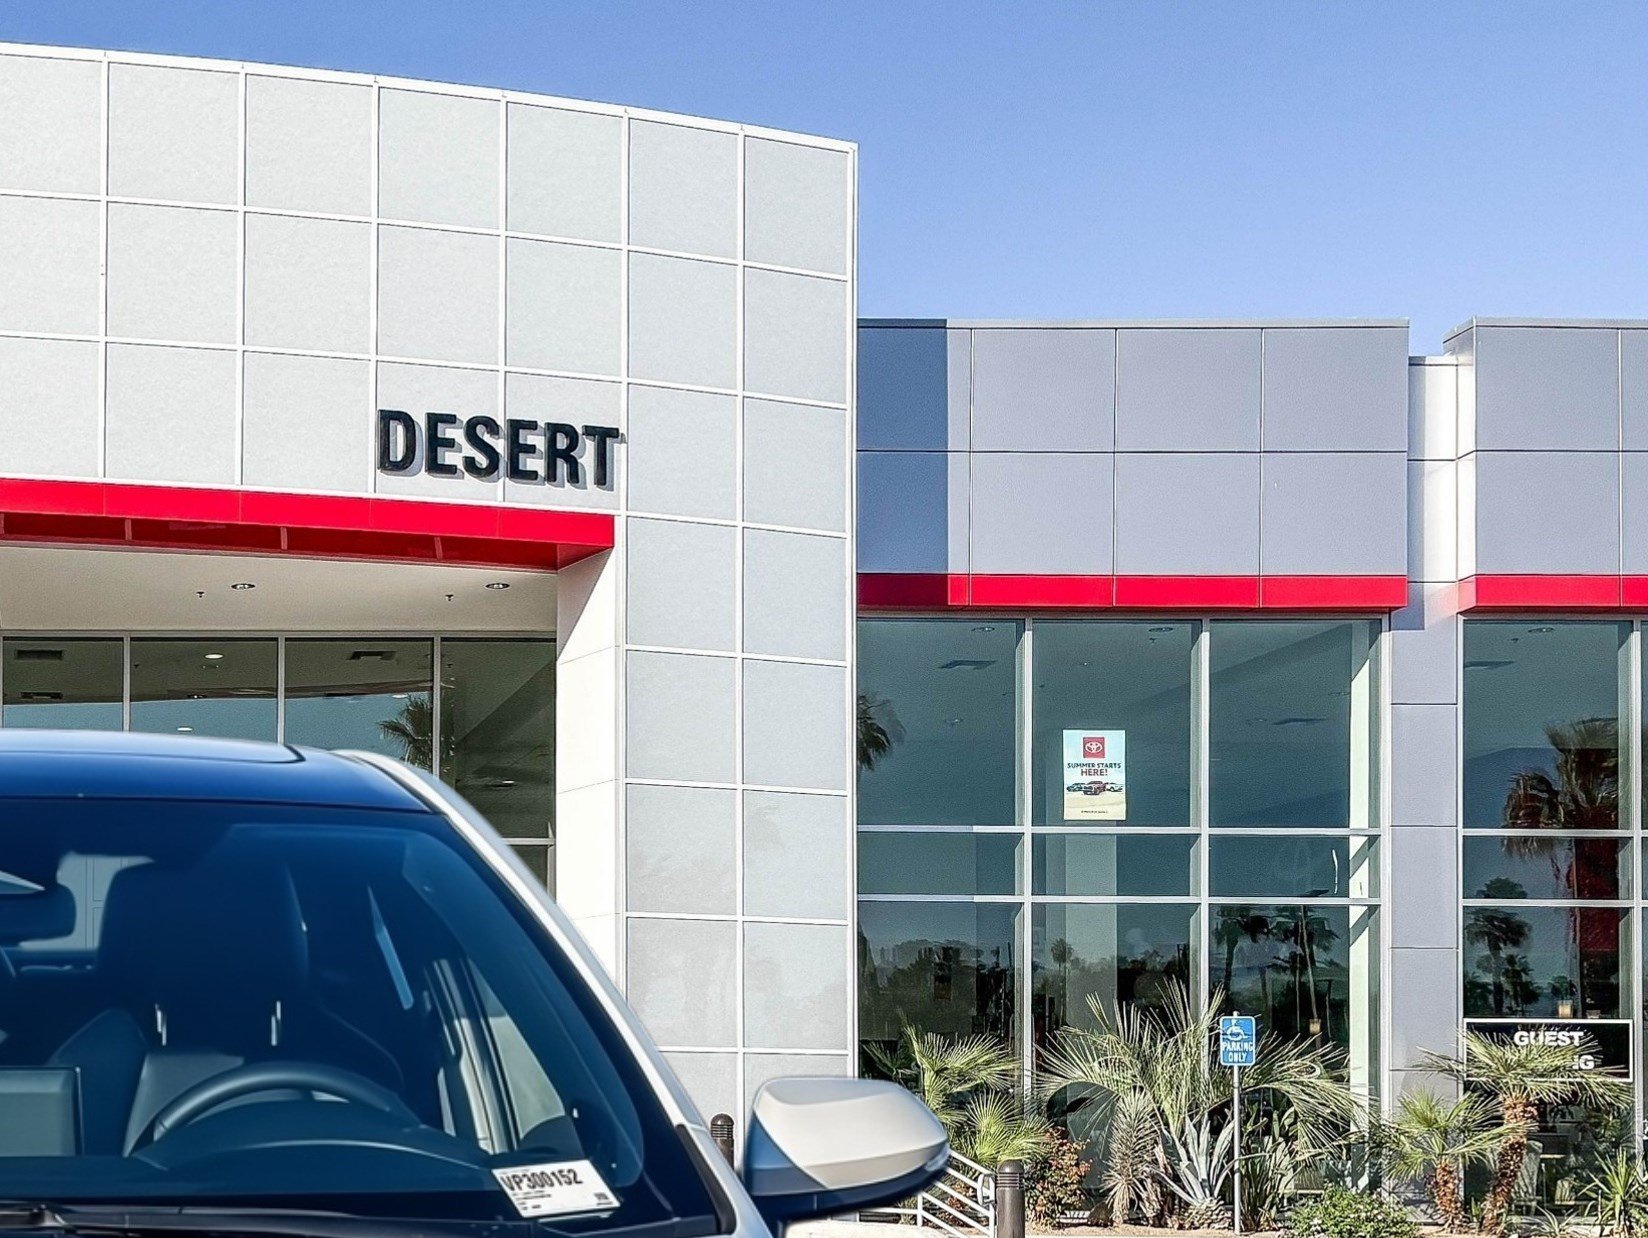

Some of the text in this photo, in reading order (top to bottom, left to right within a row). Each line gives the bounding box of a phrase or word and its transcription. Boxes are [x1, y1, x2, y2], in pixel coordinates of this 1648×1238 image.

[377, 409, 620, 486] DESERT
[1080, 768, 1108, 776] HERE!
[1513, 1031, 1584, 1047] GUEST
[1222, 1041, 1254, 1052] PARKING
[1228, 1052, 1247, 1063] ONLY
[500, 1168, 584, 1192] VP300152
